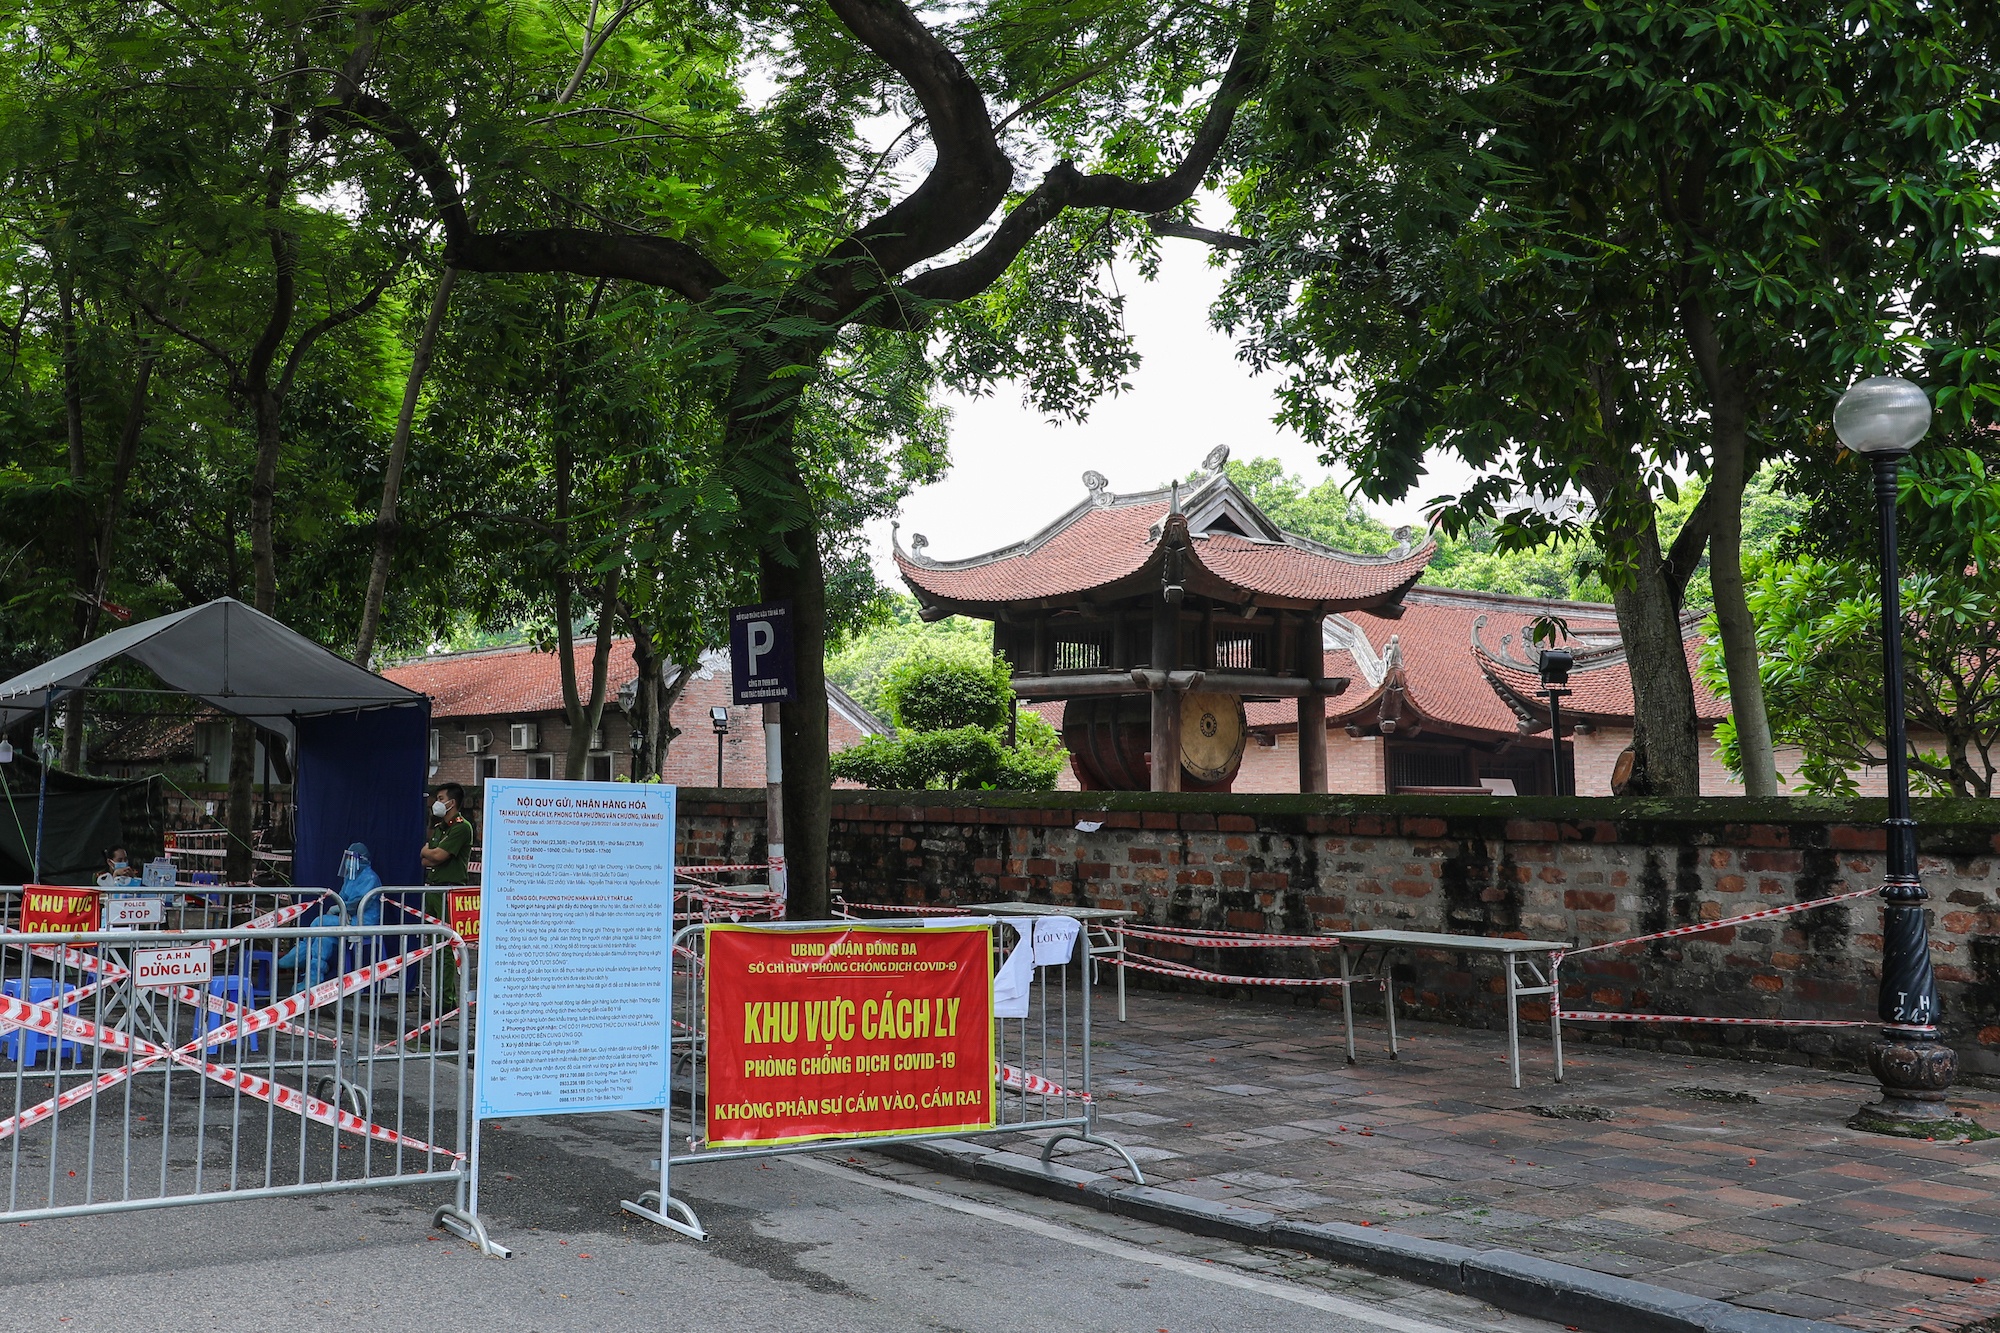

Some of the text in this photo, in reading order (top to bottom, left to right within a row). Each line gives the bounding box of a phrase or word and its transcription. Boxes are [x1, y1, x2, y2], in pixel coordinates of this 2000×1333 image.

[747, 621, 774, 676] P
[517, 796, 647, 810] NỘI QUY GỬI, NHẬN HÀNG HÓA
[30, 894, 92, 916] KHU VỰC
[120, 910, 151, 919] STOP
[156, 952, 191, 960] C.A.H.N
[791, 938, 917, 958] UBND QUẬN ĐỐNG ĐA
[140, 962, 206, 978] DỪNG LẠI
[748, 958, 957, 974] SỞ CHỈ HUY PHÒNG CHỐNG DỊCH COVID-19
[744, 990, 961, 1050] KHU VỰC CÁCH LY
[744, 1050, 956, 1078] PHÒNG CHỐNG DỊCH COVID-19
[715, 1085, 982, 1123] KHÔNG PHẬN SỰ CẤM VÀO, CẤM RA!
